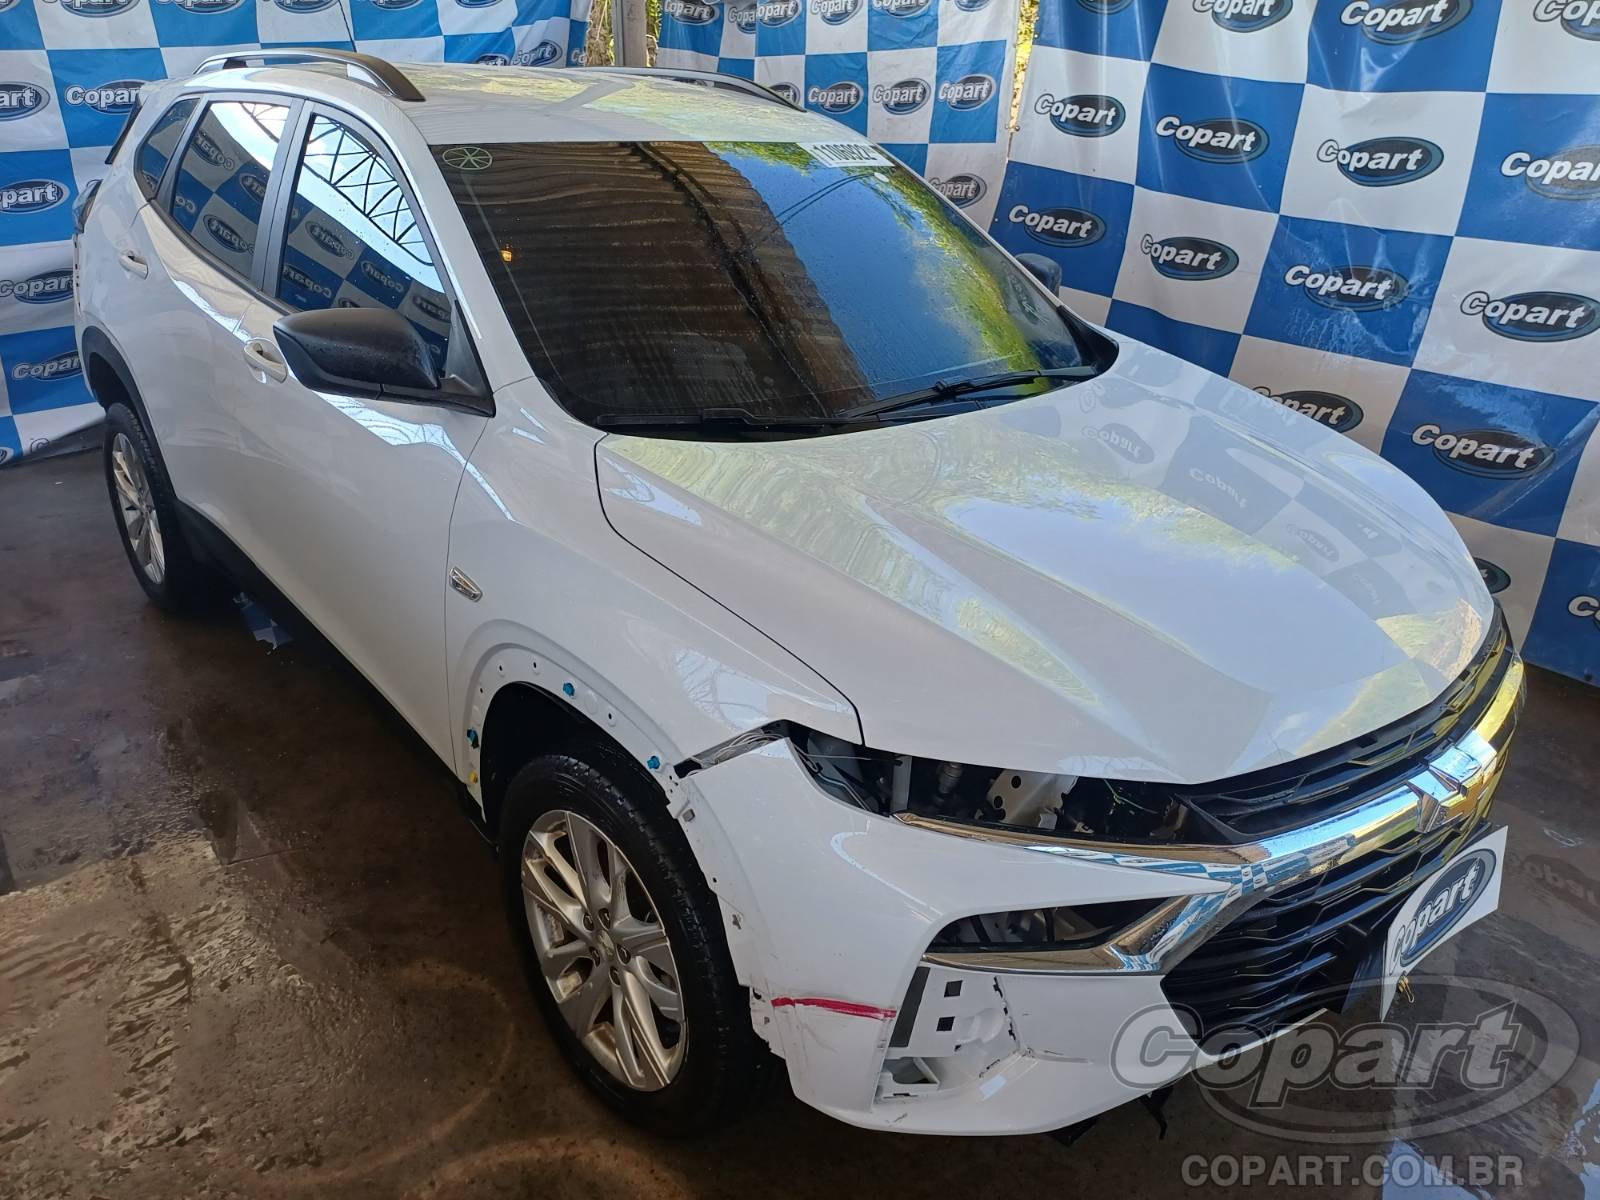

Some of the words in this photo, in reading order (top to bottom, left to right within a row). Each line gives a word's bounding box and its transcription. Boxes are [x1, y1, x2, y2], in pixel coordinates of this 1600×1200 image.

[1340, 0, 1449, 32] Copart
[808, 86, 859, 108] Copart
[872, 83, 924, 108] Copart
[938, 79, 992, 106] Copart
[1034, 93, 1118, 126] Copart
[1155, 116, 1257, 152] Copart
[1316, 138, 1423, 172] Copart
[1008, 204, 1093, 238] Copart
[1140, 233, 1224, 271] Copart
[1284, 263, 1392, 301] Copart
[1460, 290, 1587, 329] Copart
[1411, 422, 1537, 469] Copart
[1389, 856, 1481, 977] Copart
